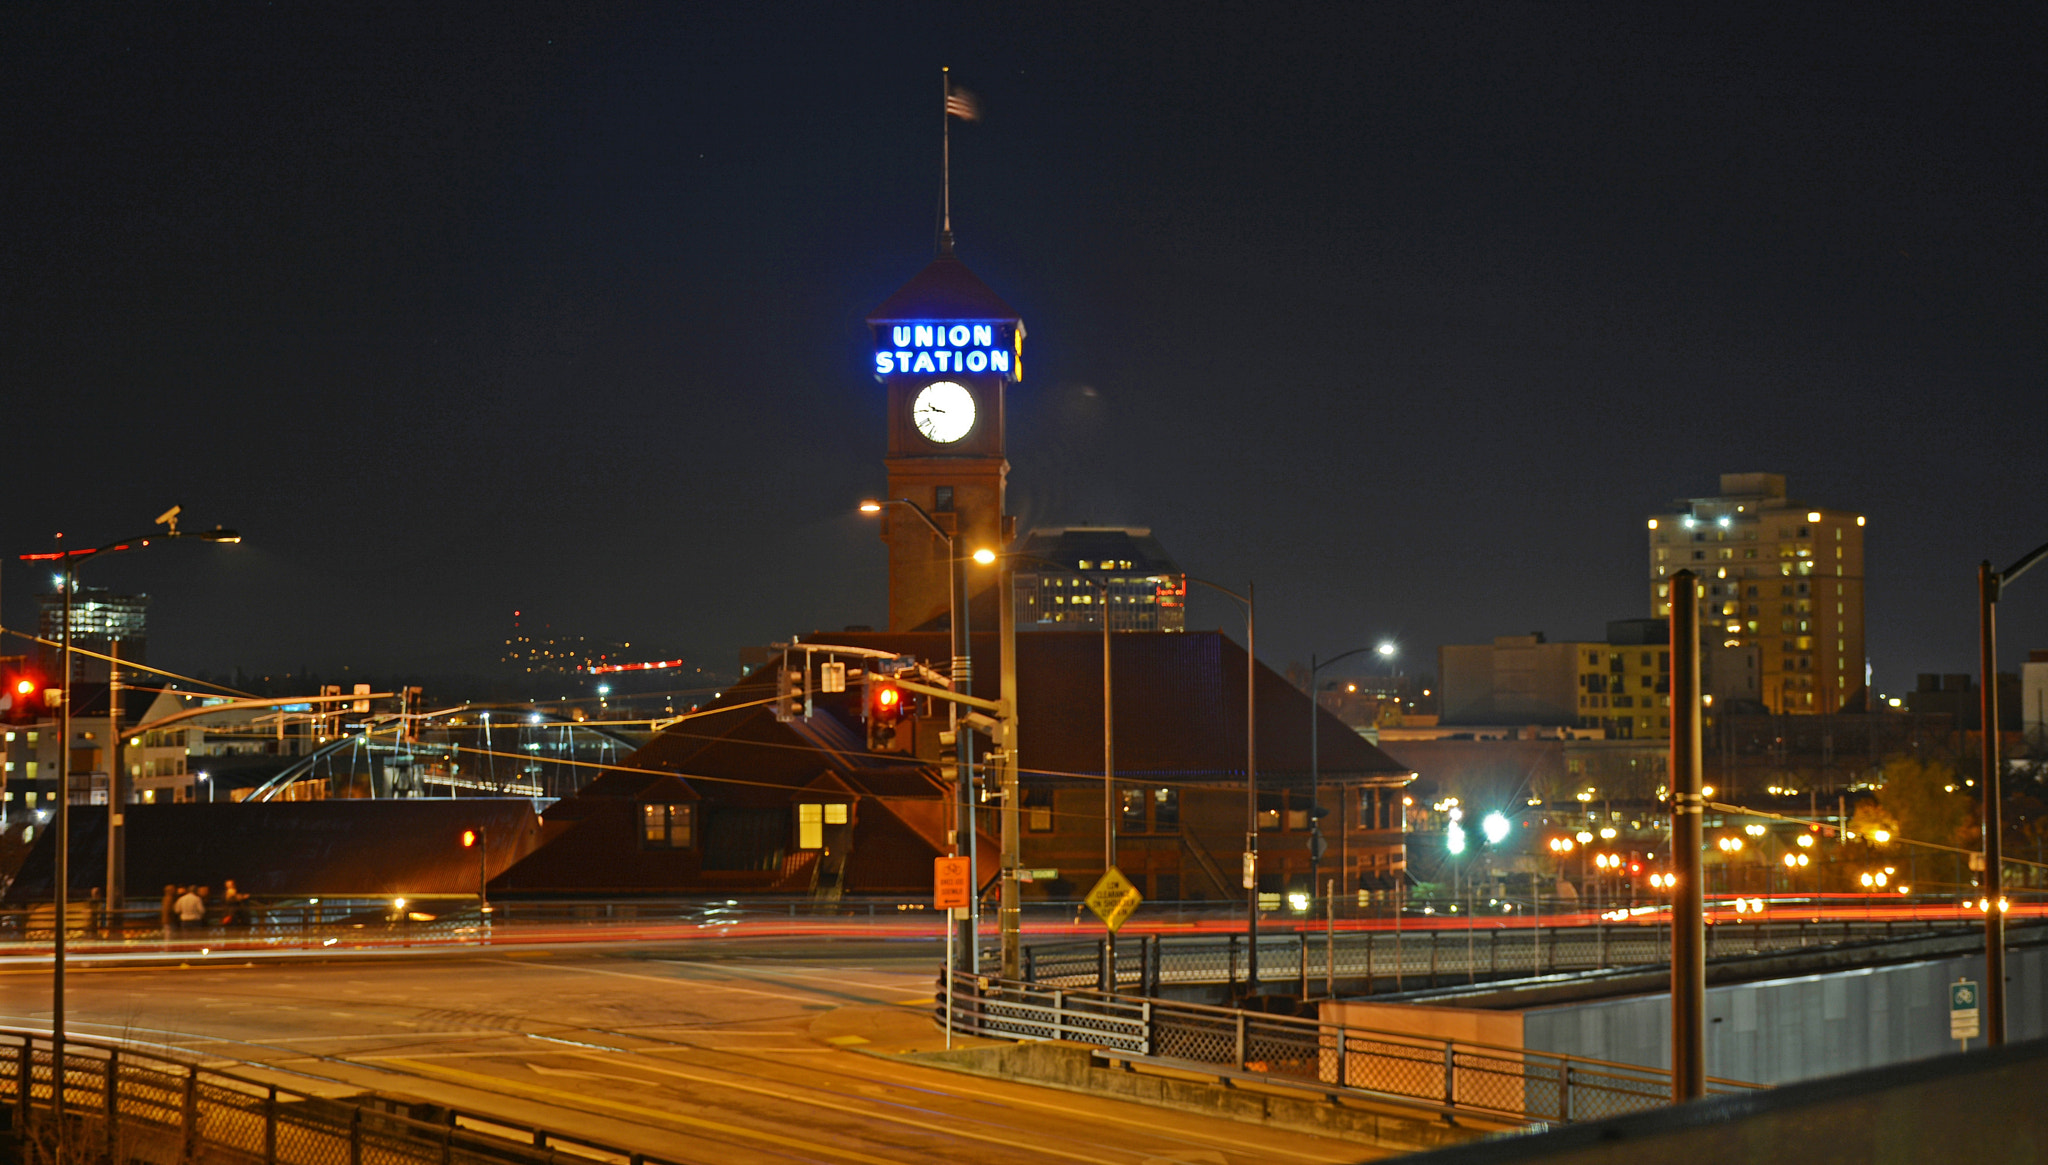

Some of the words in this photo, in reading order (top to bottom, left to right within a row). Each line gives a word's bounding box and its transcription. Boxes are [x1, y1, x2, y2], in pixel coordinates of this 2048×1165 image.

[893, 325, 992, 347] UNION
[876, 350, 1009, 374] STATION
[1104, 899, 1135, 907] SHOUDER
